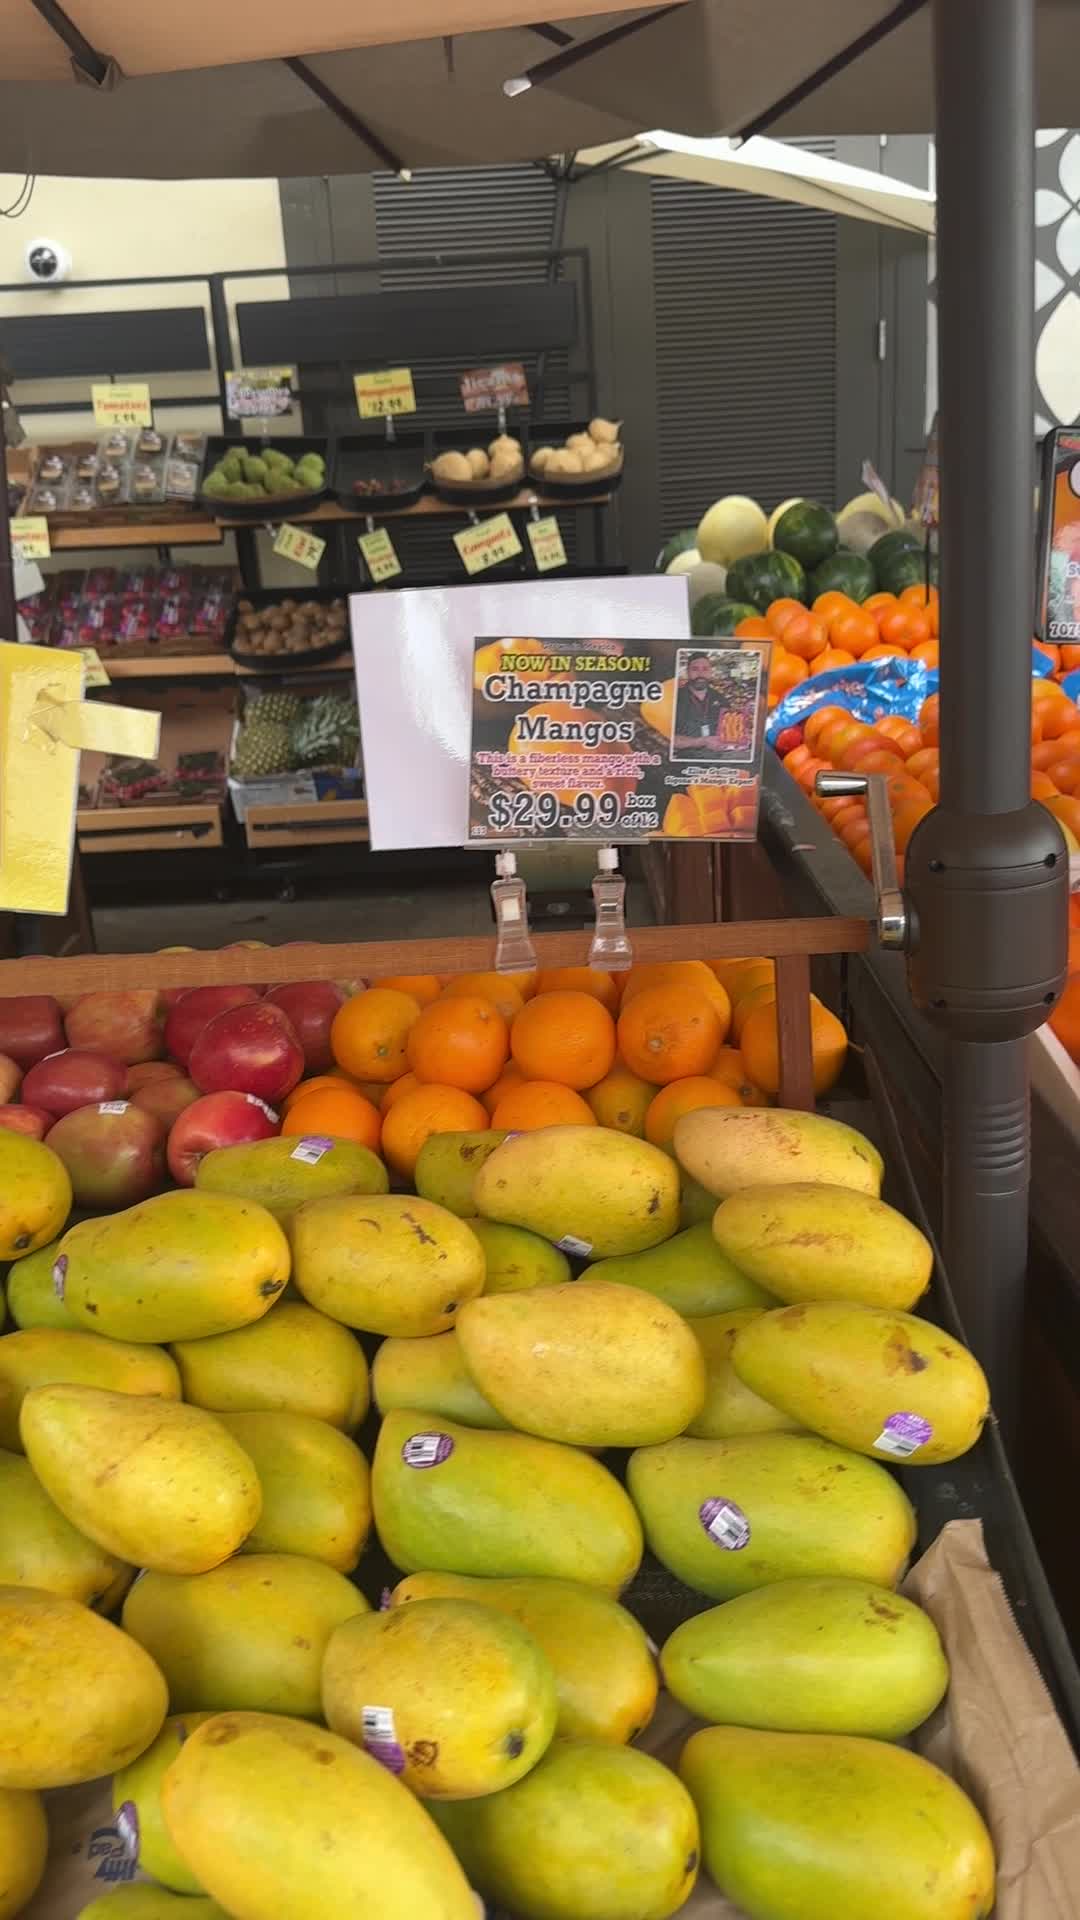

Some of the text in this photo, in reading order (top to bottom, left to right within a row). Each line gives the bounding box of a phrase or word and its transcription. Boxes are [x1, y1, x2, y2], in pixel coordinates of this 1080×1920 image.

[501, 654, 652, 673] NOW IN SEASON!
[484, 673, 662, 708] Champagne
[517, 715, 634, 748] Mangos
[478, 752, 661, 768] This is a fiberless mango with a
[493, 766, 644, 779] buttery texture and a rich,
[532, 778, 605, 789] sweet flavor.
[625, 791, 657, 808] box
[488, 790, 620, 831] $29.99
[621, 812, 659, 828] of 12
